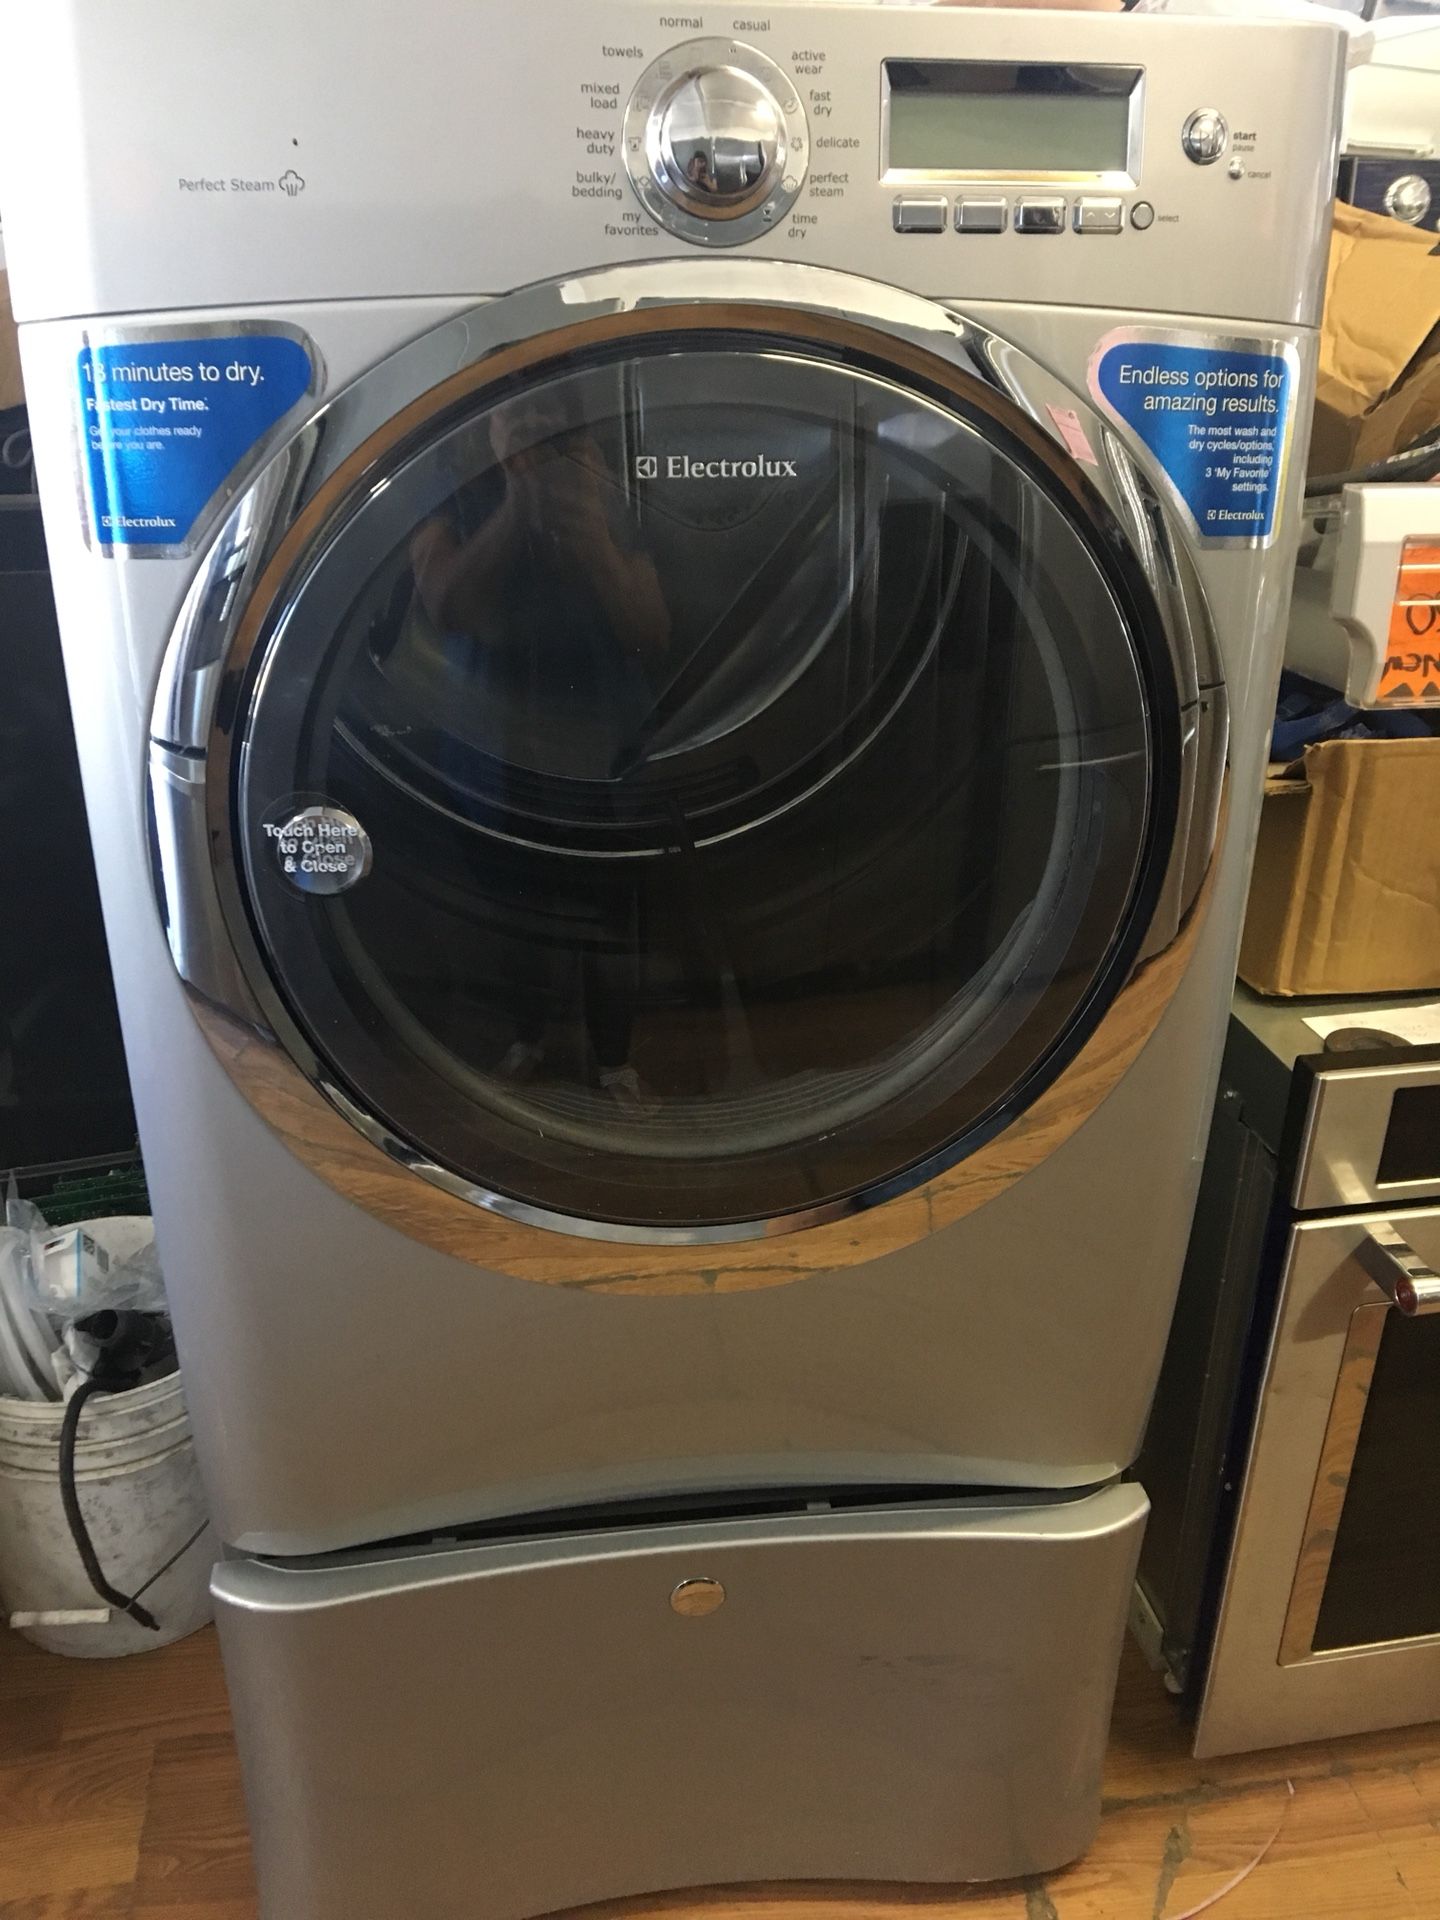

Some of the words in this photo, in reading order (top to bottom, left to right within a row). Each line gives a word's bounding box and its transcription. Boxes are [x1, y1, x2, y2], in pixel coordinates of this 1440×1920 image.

[659, 16, 703, 28] normal
[732, 19, 771, 31] casual
[601, 45, 643, 58] towels
[791, 50, 826, 62] active
[795, 65, 823, 75] wear
[580, 83, 620, 95] mixed
[809, 90, 831, 102] fast
[590, 97, 618, 109] load
[813, 104, 832, 118] dry
[576, 128, 615, 142] heavy
[1233, 131, 1257, 141] start
[586, 142, 615, 156] duty
[816, 137, 860, 148] delicate
[178, 178, 226, 192] Perfect
[230, 178, 275, 192] Steam
[576, 172, 616, 187] bulky/
[809, 173, 849, 187] perfect
[572, 186, 622, 200] bedding
[809, 186, 844, 197] steam
[622, 212, 641, 225] my
[792, 214, 818, 225] time
[1158, 215, 1179, 223] select
[604, 222, 659, 236] favorites
[788, 227, 807, 240] dry
[112, 360, 194, 382] minutes
[198, 362, 220, 382] to
[225, 361, 266, 387] dry.
[1119, 364, 1189, 385] Endless
[1194, 368, 1258, 390] options
[1262, 369, 1284, 388] for
[86, 398, 138, 411] Fstest
[140, 397, 166, 414] Dry
[1143, 392, 1217, 416] amazing
[1222, 394, 1280, 414] results.
[89, 425, 107, 437] Ge
[134, 426, 172, 436] clothes
[173, 426, 202, 438] ready
[1188, 424, 1206, 435] The
[1208, 426, 1232, 436] most
[1234, 426, 1259, 437] wash
[1260, 427, 1277, 437] and
[91, 440, 123, 451] bere
[1188, 439, 1205, 452] dry
[666, 454, 797, 479] Electrolux
[1232, 453, 1273, 467] including
[1205, 467, 1213, 478] 3
[1231, 483, 1269, 494] settings.
[117, 515, 177, 528] Electrolux
[1218, 510, 1265, 521] Electrolux
[262, 823, 314, 838] Touch
[319, 823, 358, 837] Here
[280, 841, 298, 854] to
[301, 840, 346, 856] Open
[284, 859, 297, 873] &
[300, 859, 348, 873] Close
